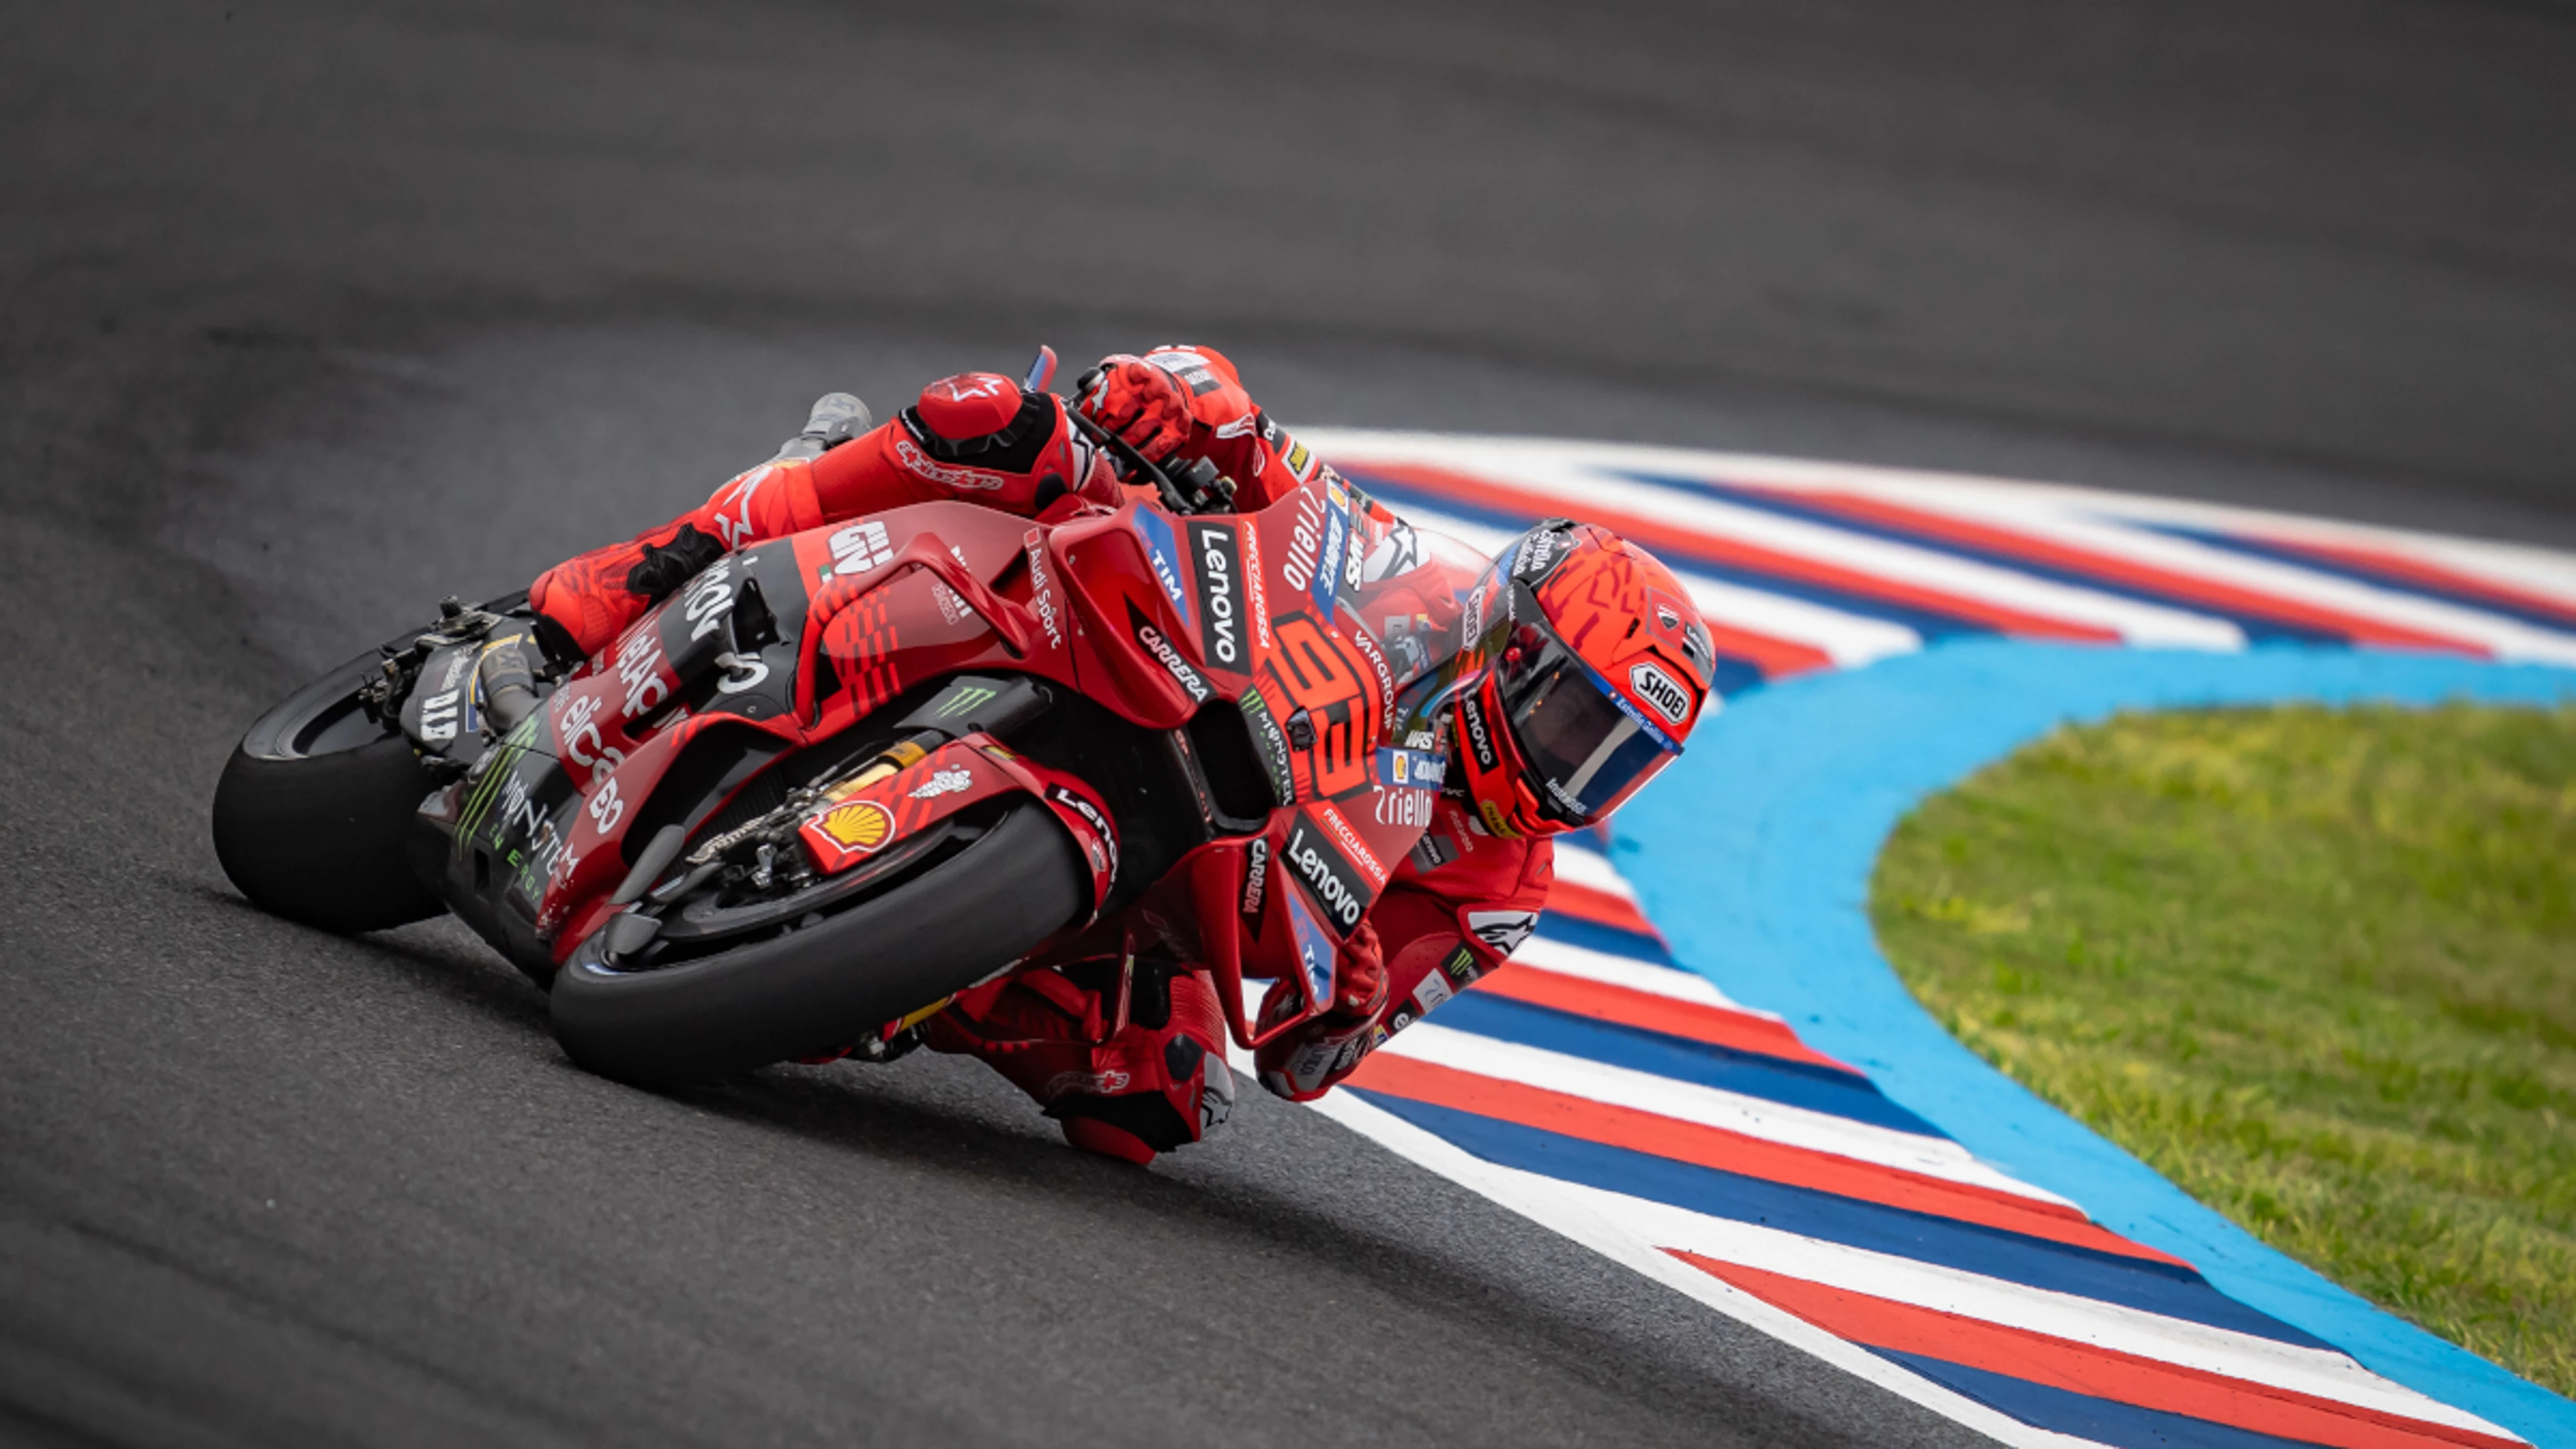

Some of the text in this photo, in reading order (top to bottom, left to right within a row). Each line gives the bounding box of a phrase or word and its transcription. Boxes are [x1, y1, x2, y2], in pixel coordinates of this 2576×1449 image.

[1153, 549, 1183, 602] TIM
[1283, 499, 1324, 591] riello
[1029, 548, 1061, 649] Audi Sport
[1201, 529, 1236, 663] Lenovo
[1139, 627, 1208, 702] CARRERA
[1355, 631, 1394, 730] VARGROUP
[1640, 672, 1689, 715] SHOEI
[1271, 609, 1372, 798] 93
[1463, 688, 1493, 765] Lenovo
[1259, 711, 1293, 808] MONSTER
[1388, 787, 1432, 827] riello
[1243, 839, 1267, 914] CARRERA
[1288, 828, 1360, 924] Lenovo
[1324, 808, 1387, 884] FRECCIAROSSA
[1412, 830, 1442, 864] enovo
